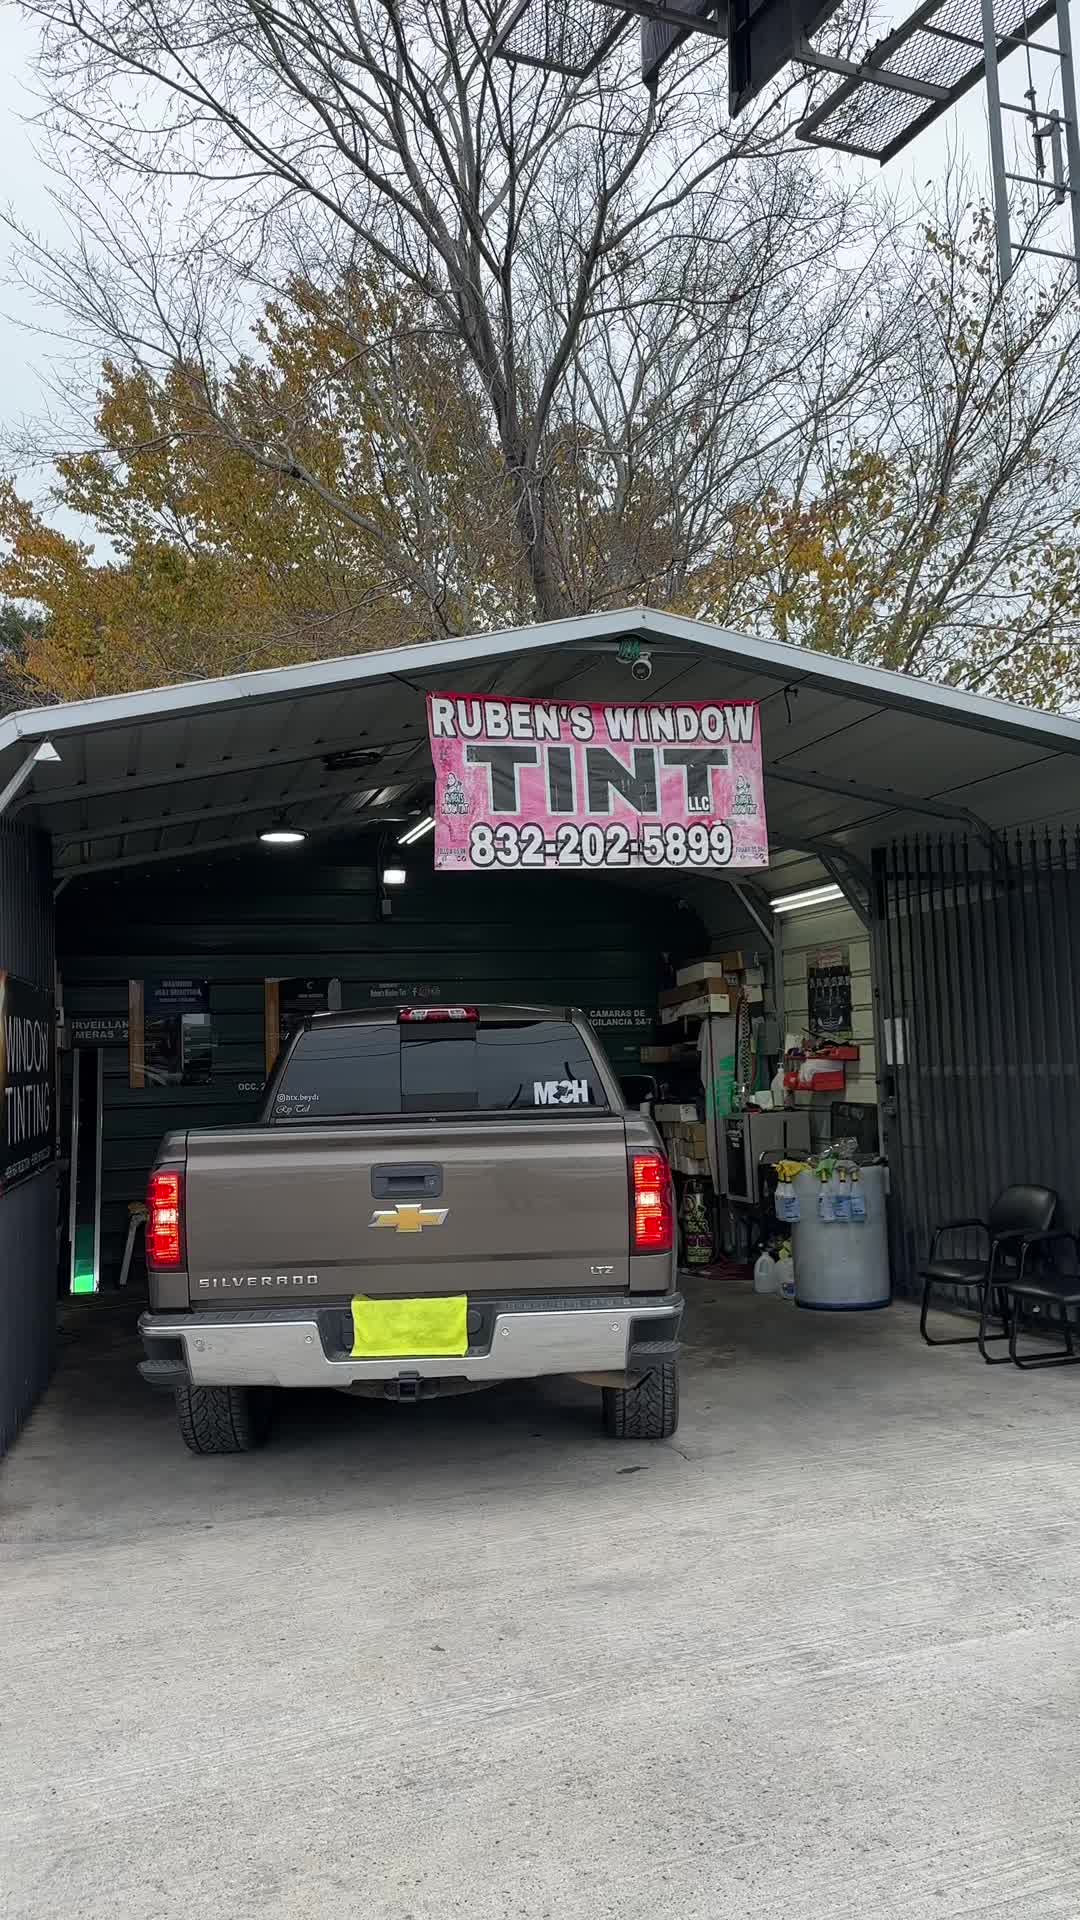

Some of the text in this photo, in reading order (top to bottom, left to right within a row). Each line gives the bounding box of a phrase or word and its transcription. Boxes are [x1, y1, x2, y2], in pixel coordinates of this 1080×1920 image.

[430, 697, 756, 743] RUBEN'S WINDOW
[462, 742, 732, 816] TINT
[687, 795, 711, 812] LLC
[469, 822, 734, 868] 832-202-5899
[589, 1009, 646, 1018] CAMARAS DE
[5, 1016, 49, 1073] WINDOW
[73, 1029, 114, 1039] MERAS
[238, 1082, 259, 1091] OCC.
[533, 1079, 588, 1105] MECH
[5, 1082, 50, 1145] TINTING
[199, 1274, 319, 1288] SILVERADO
